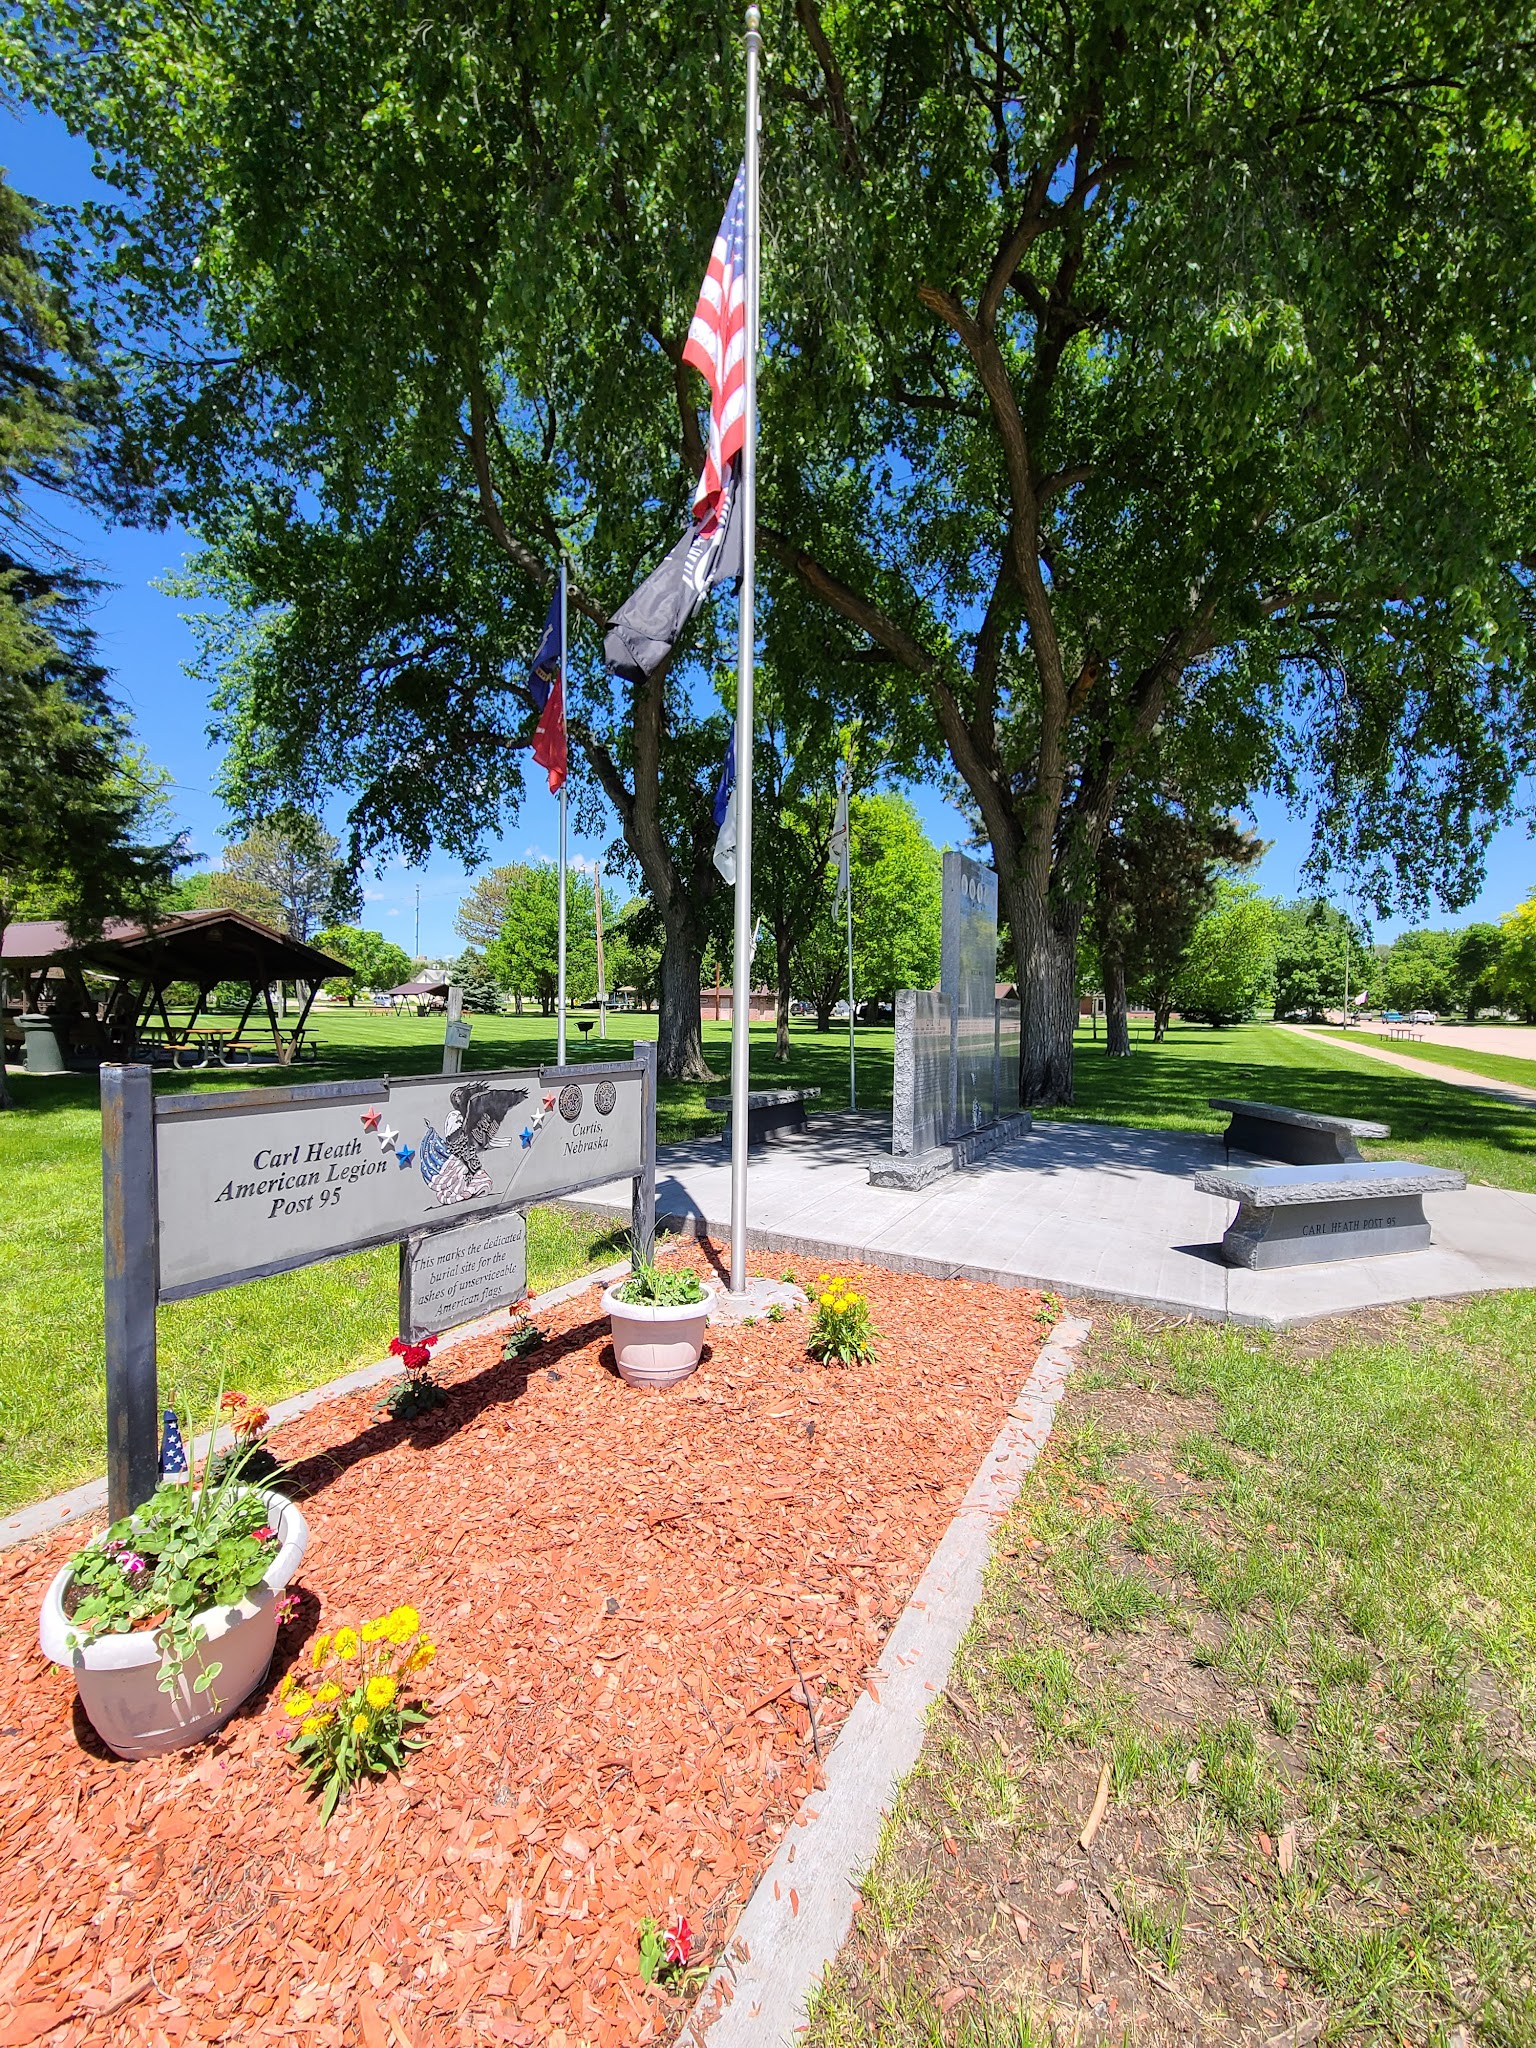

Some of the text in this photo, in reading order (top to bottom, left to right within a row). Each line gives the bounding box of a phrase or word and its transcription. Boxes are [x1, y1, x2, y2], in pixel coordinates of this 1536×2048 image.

[572, 1120, 603, 1137] Curtis,
[253, 1137, 362, 1170] Carl Heath
[563, 1137, 608, 1156] Nebraska
[214, 1159, 388, 1203] American Legion
[267, 1186, 342, 1219] Post 95
[1302, 1217, 1397, 1236] CARL HEATH POST 95
[413, 1229, 522, 1273] This marks the dedicated
[430, 1251, 507, 1284] burial site for the
[418, 1263, 517, 1306] ashes of unserviceable
[434, 1286, 502, 1318] American flags
